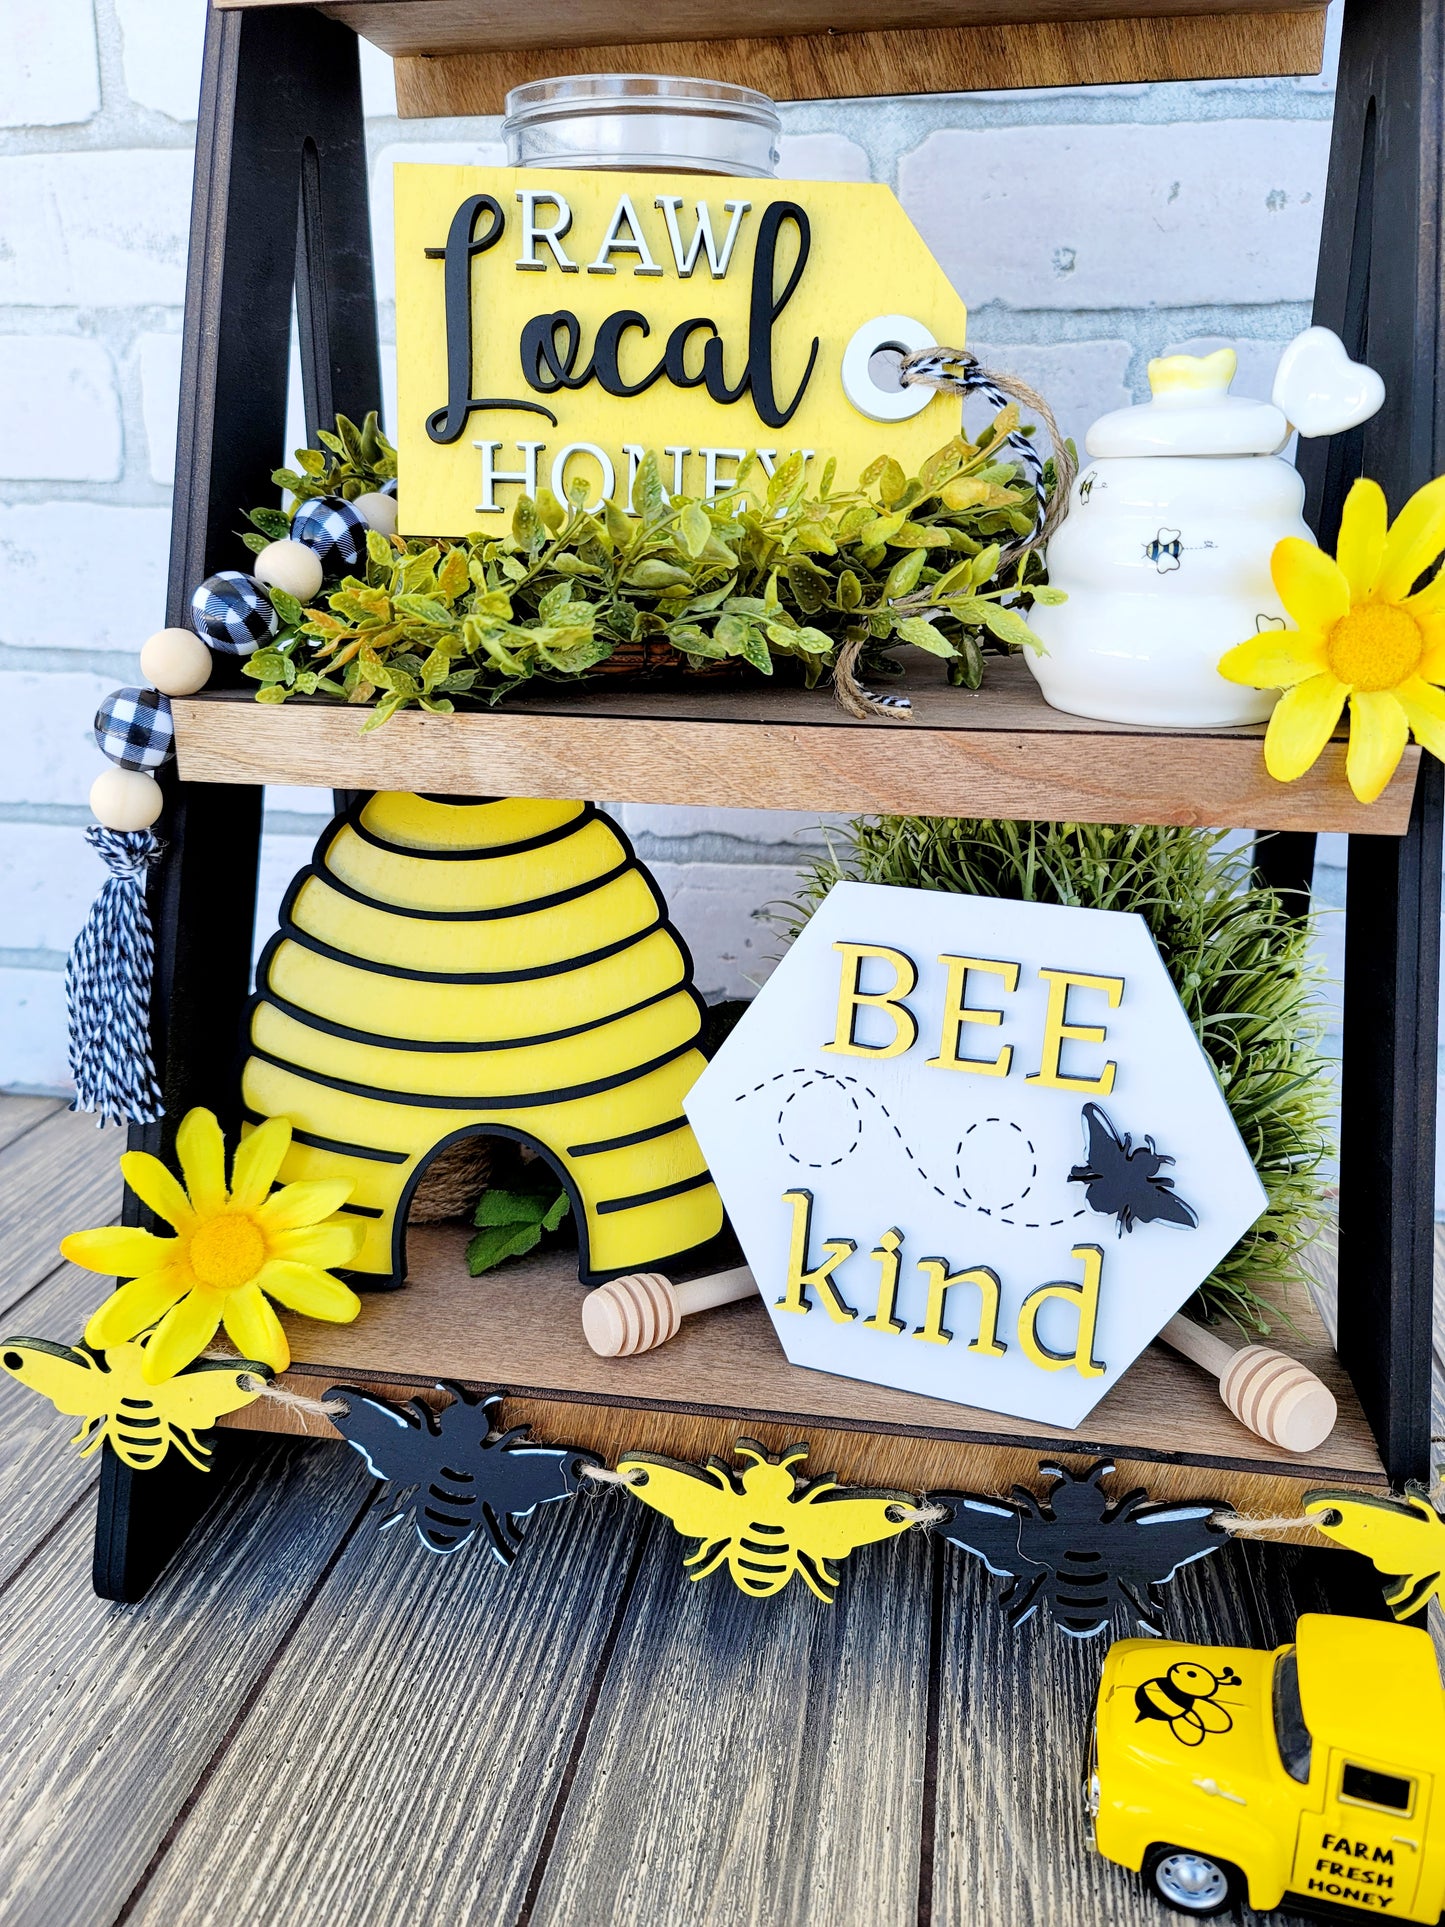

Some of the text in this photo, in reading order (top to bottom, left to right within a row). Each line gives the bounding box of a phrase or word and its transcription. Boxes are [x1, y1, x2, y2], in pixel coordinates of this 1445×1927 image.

[516, 189, 751, 278] RAW
[424, 193, 819, 444] Local
[821, 941, 1125, 1096] BEE
[774, 1188, 1107, 1378] kind
[1308, 1878, 1394, 1908] HONEY
[1316, 1859, 1393, 1888] FRESH
[1322, 1833, 1394, 1865] FARM
